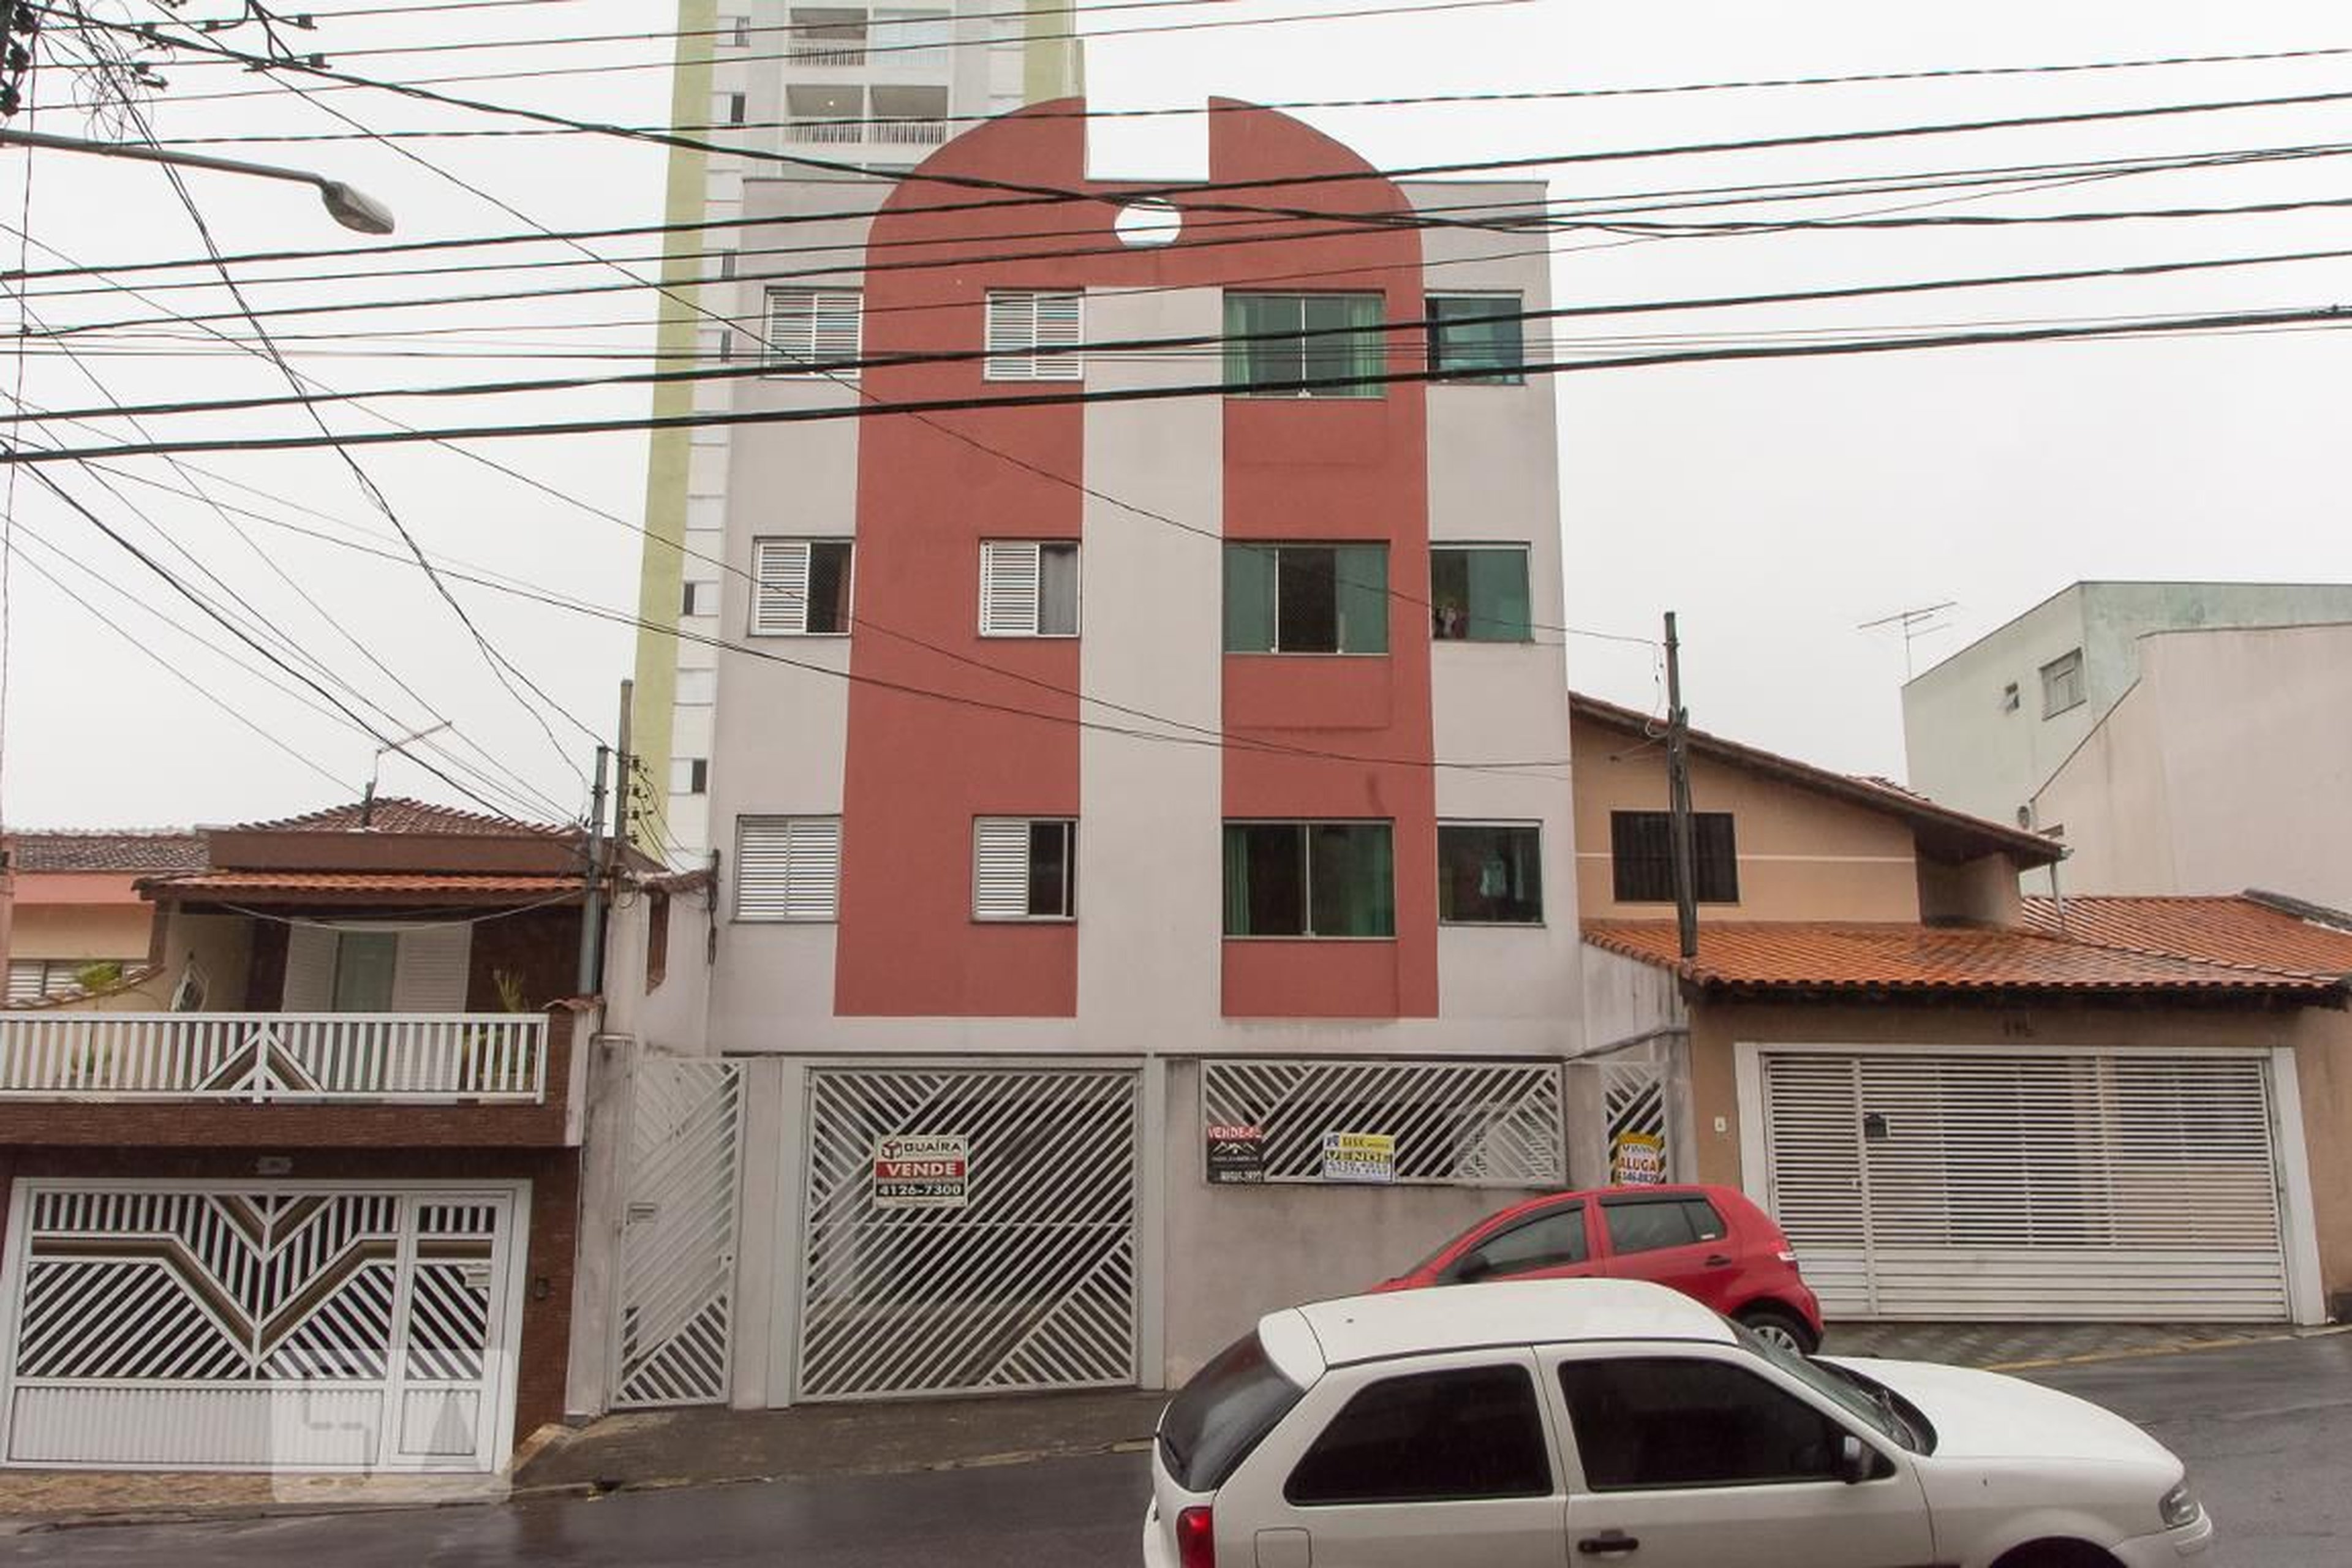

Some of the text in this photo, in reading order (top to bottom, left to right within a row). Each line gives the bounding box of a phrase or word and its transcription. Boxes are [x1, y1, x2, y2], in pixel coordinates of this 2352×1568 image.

[886, 1163, 957, 1177] VENDE
[1617, 1156, 1657, 1172] ALUGA
[878, 1184, 961, 1196] 4126-7300
